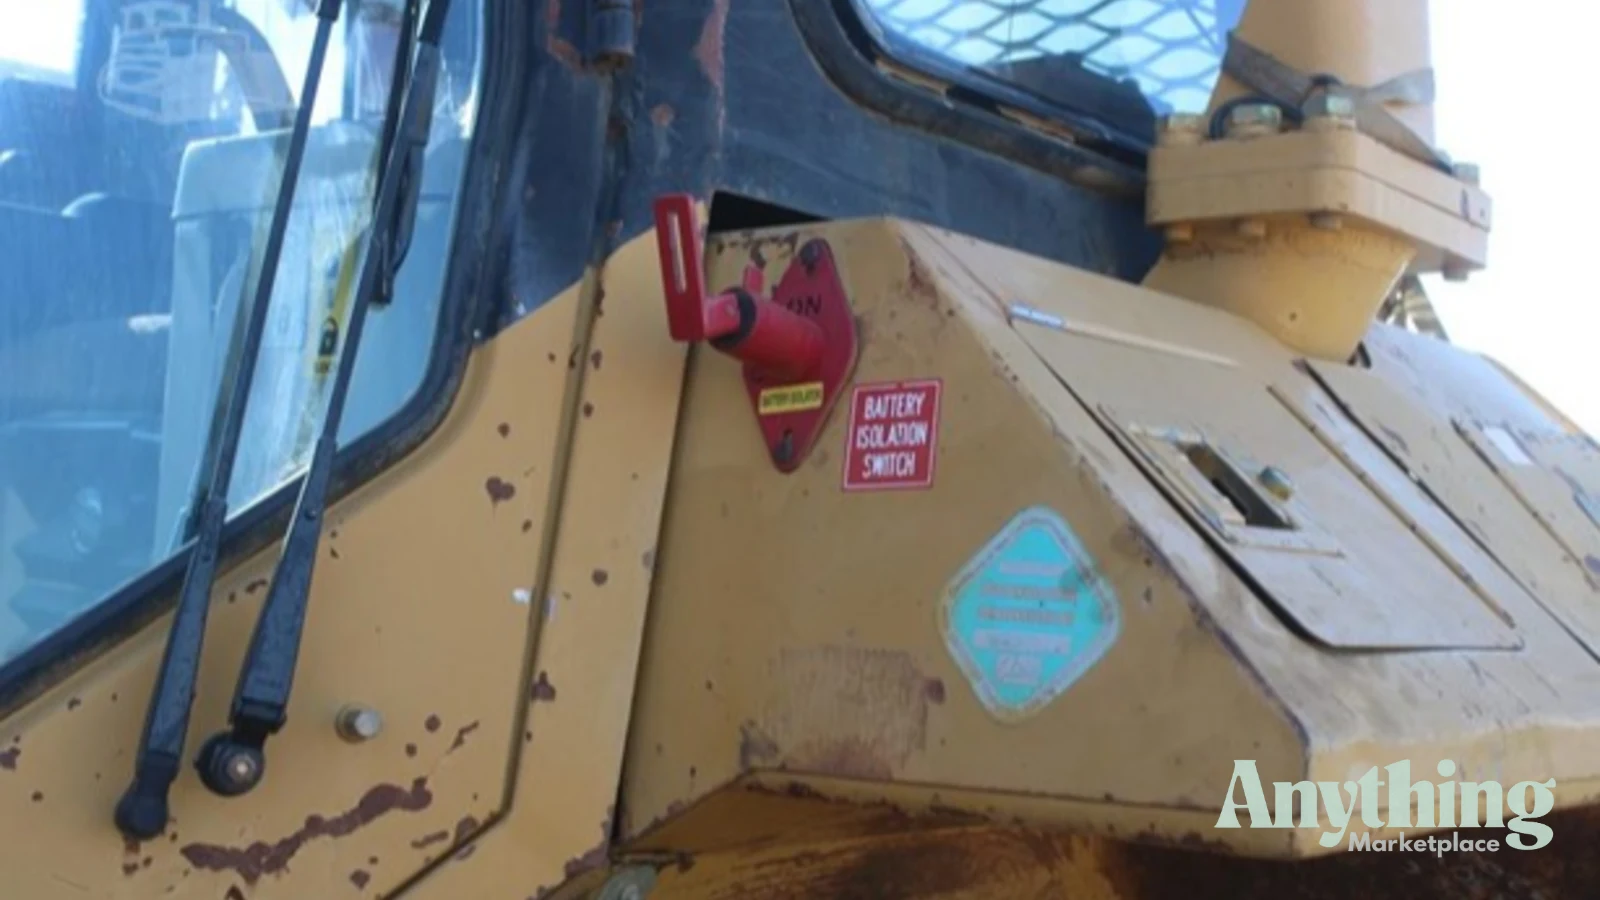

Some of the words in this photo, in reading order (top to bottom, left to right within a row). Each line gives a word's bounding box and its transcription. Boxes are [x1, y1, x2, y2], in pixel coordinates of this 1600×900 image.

[786, 294, 822, 316] ON
[864, 392, 926, 420] BATTERY
[856, 422, 928, 449] ISOLATION
[862, 452, 916, 478] SWITCH
